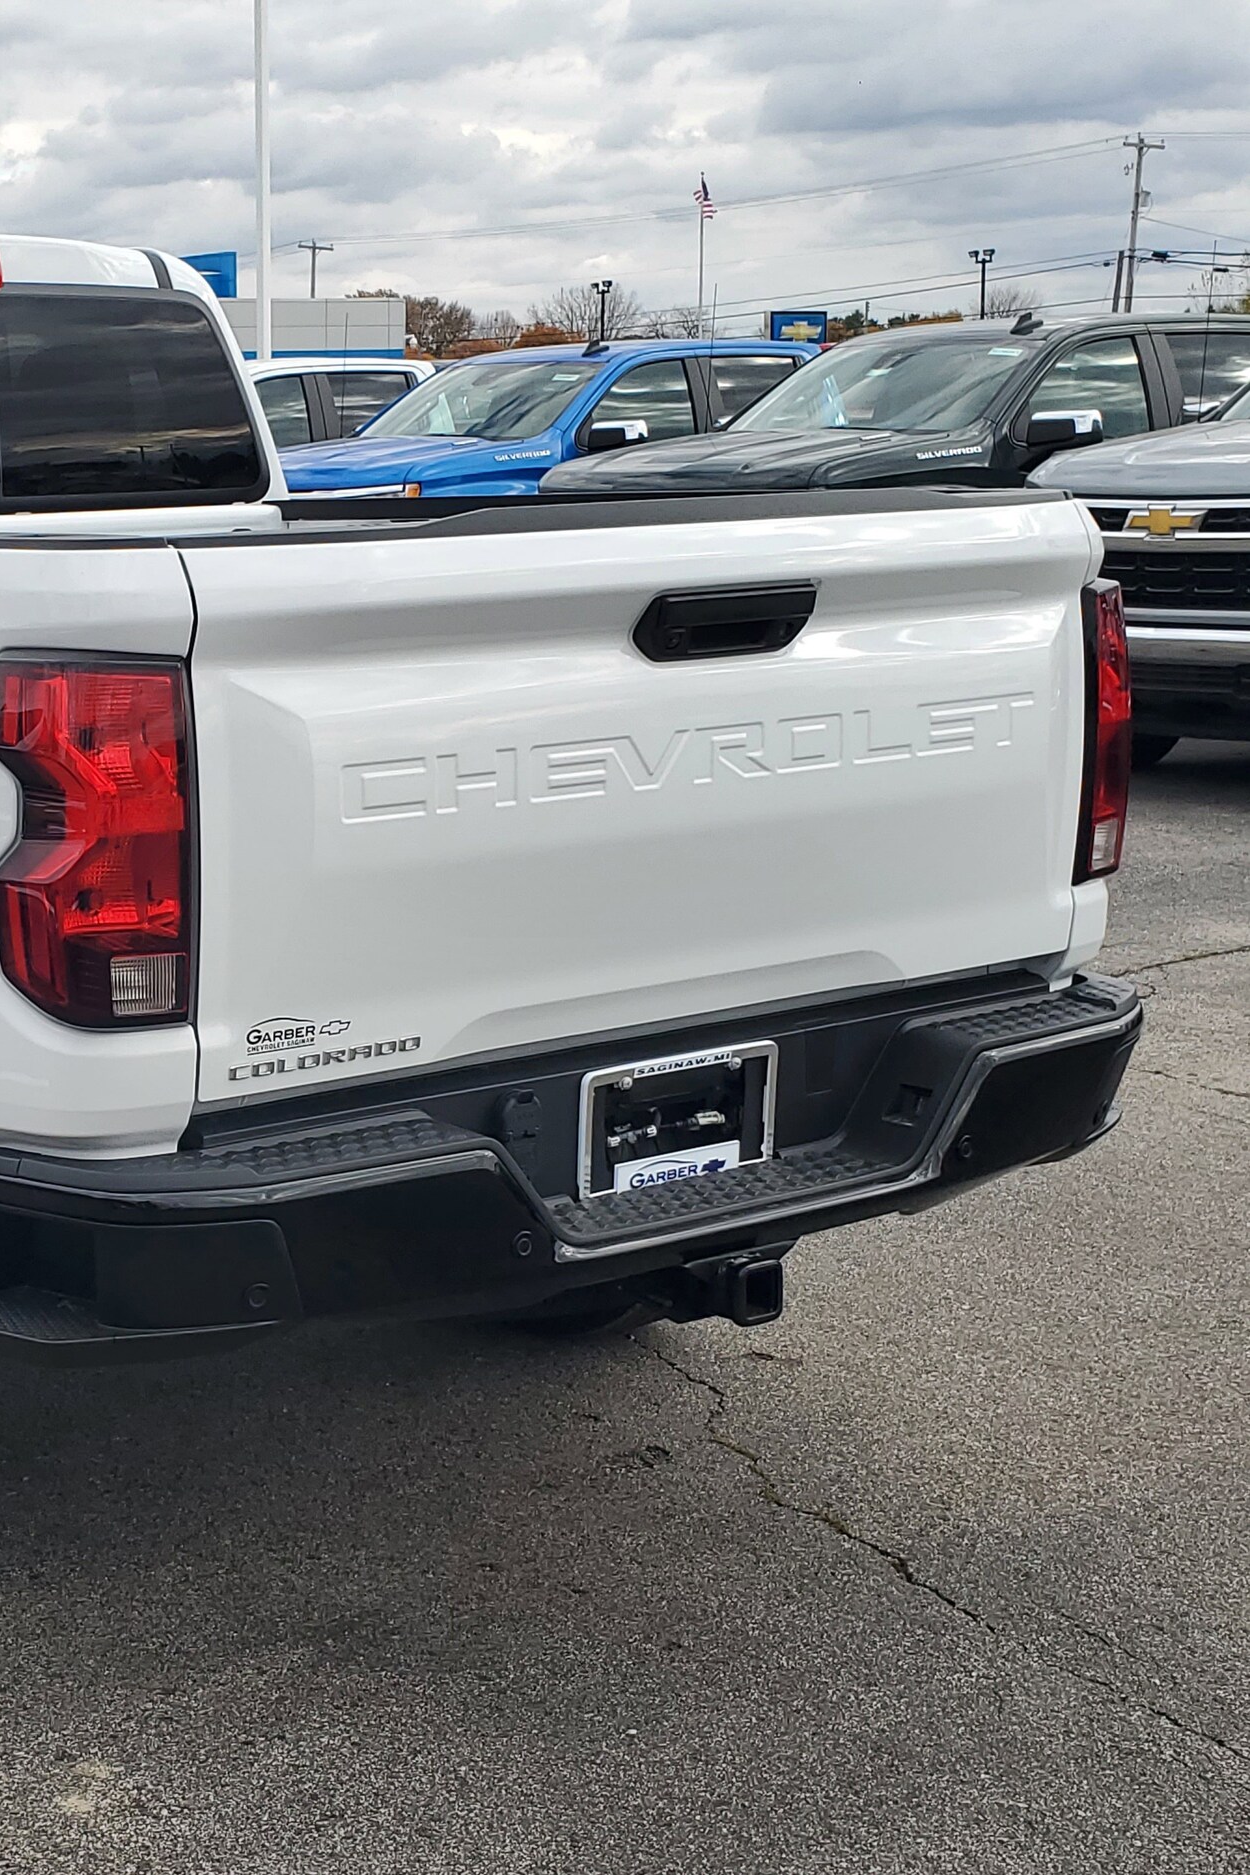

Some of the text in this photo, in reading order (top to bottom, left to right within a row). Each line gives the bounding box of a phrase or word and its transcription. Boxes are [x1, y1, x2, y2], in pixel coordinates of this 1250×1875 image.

[916, 445, 983, 460] SILVERADO
[340, 690, 1035, 824] CHEVROLET
[246, 1025, 316, 1046] GARBER
[246, 1041, 286, 1053] CHEVROLET
[228, 1035, 422, 1081] COLORADO
[629, 1163, 699, 1189] GARBER
